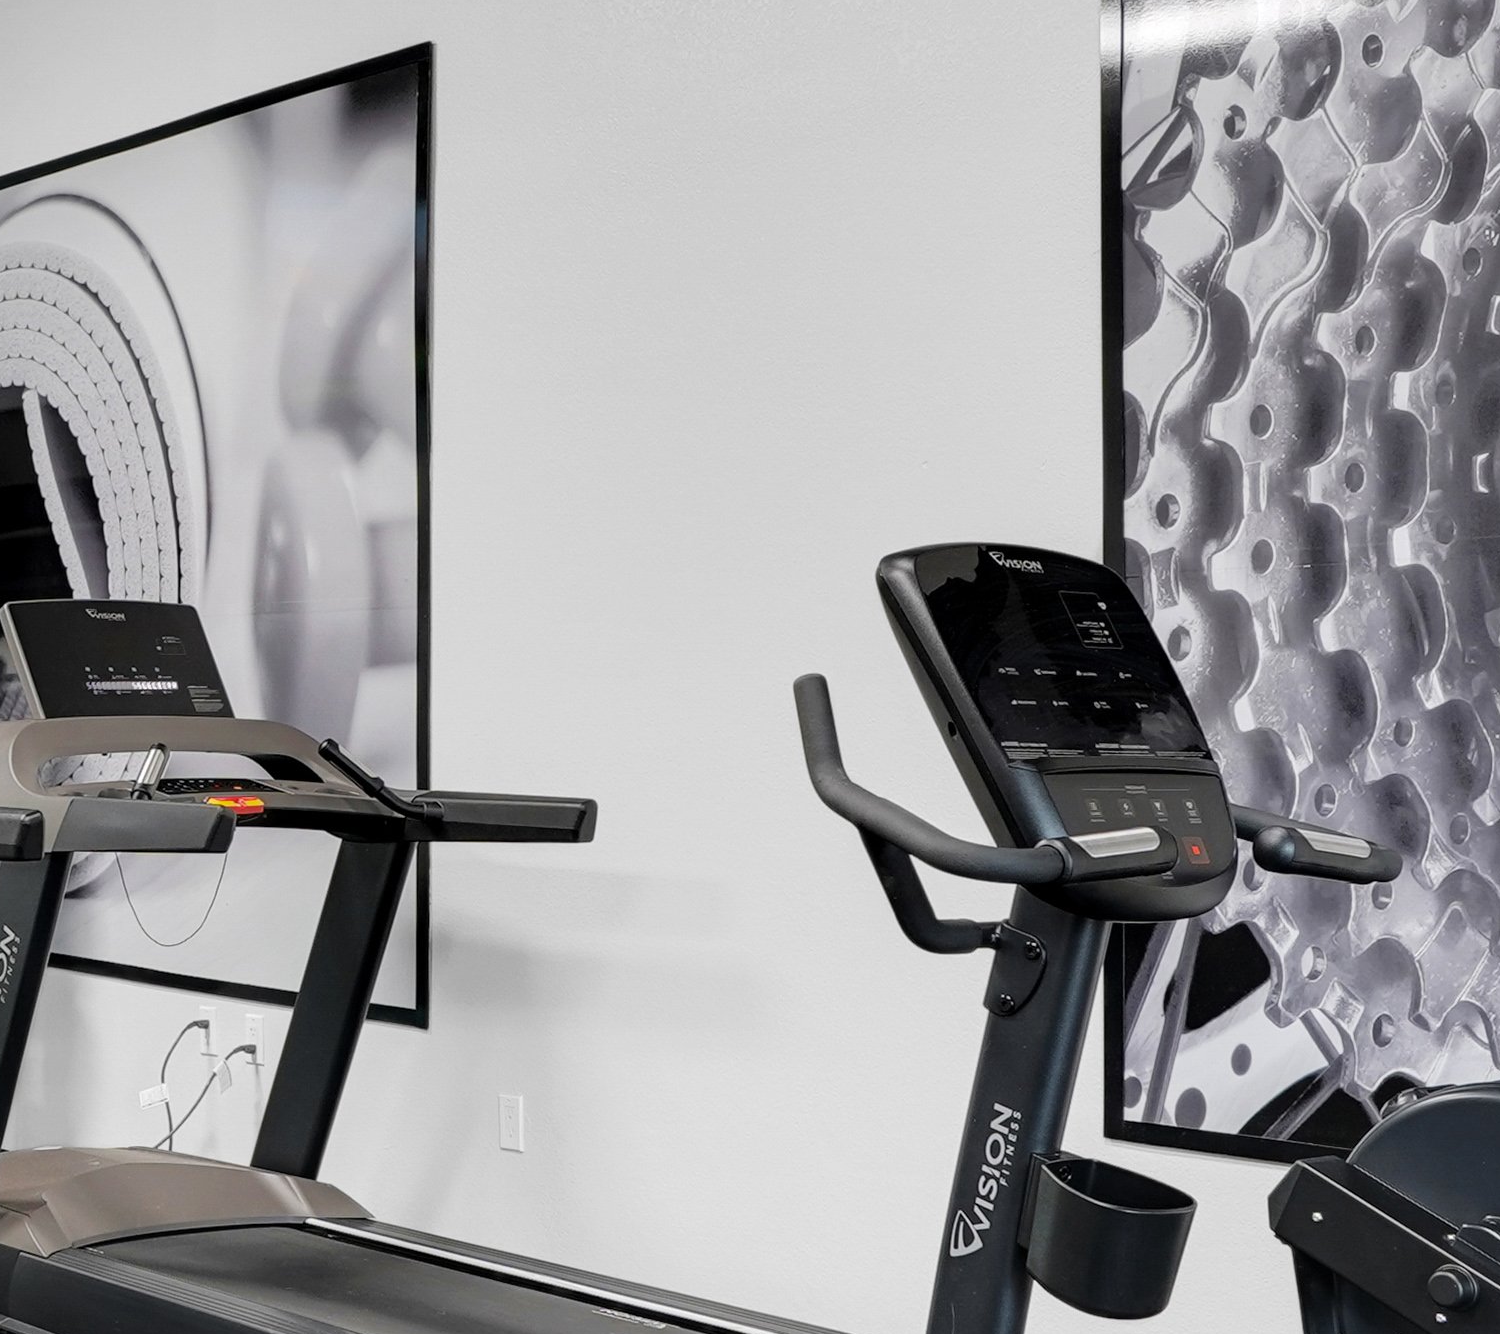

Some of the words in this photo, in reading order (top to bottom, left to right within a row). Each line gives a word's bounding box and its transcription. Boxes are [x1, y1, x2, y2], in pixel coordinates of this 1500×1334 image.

[0, 936, 21, 1004] FITNESS
[973, 1102, 1014, 1231] VISION
[999, 1110, 1022, 1188] FITNESS
